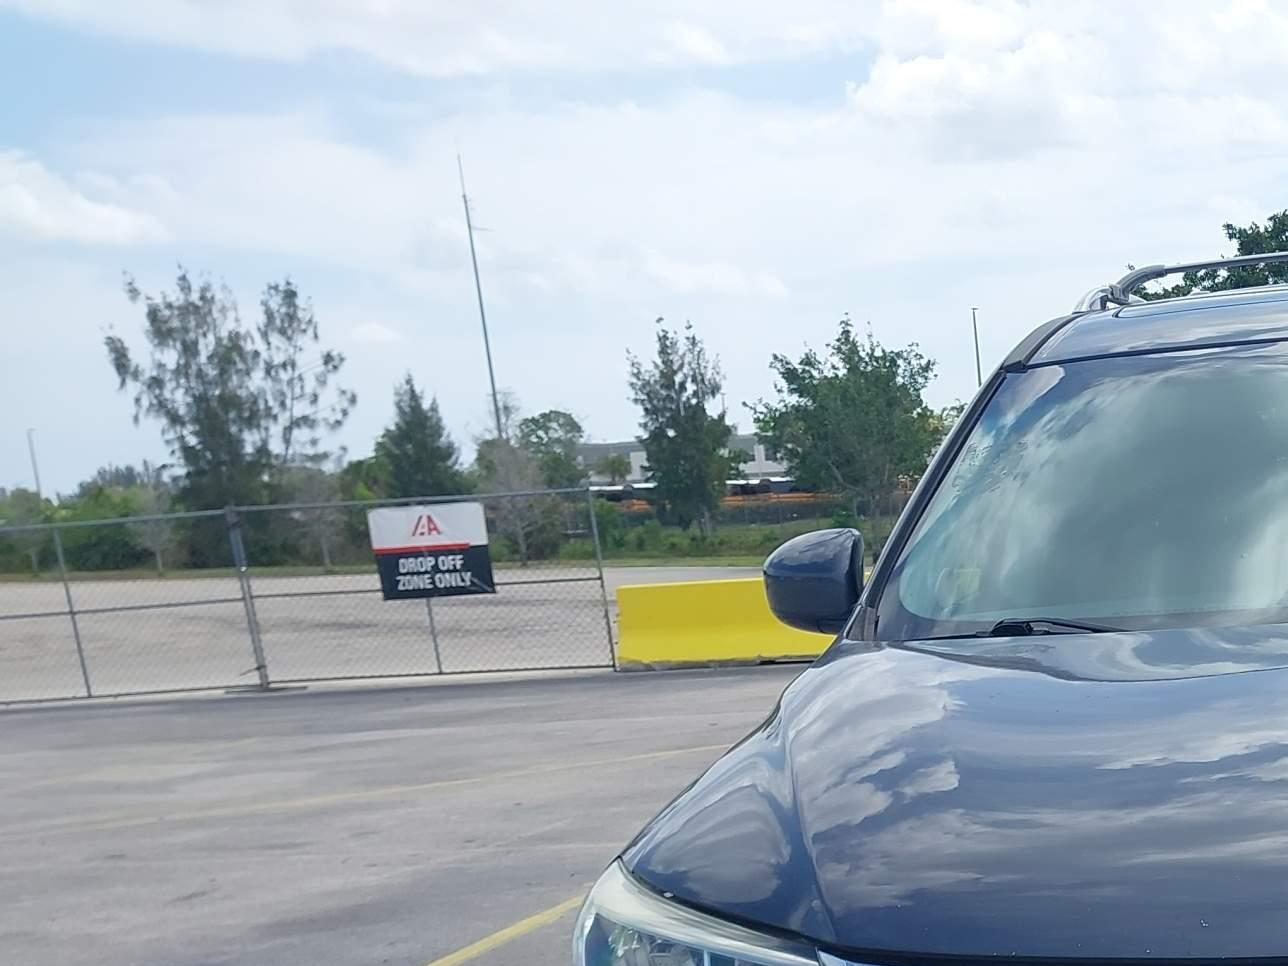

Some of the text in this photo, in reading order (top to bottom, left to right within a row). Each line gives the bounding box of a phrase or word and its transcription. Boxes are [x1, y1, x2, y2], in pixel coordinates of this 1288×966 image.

[398, 554, 464, 573] DROP OFF
[396, 571, 472, 591] ZONE ONLY
